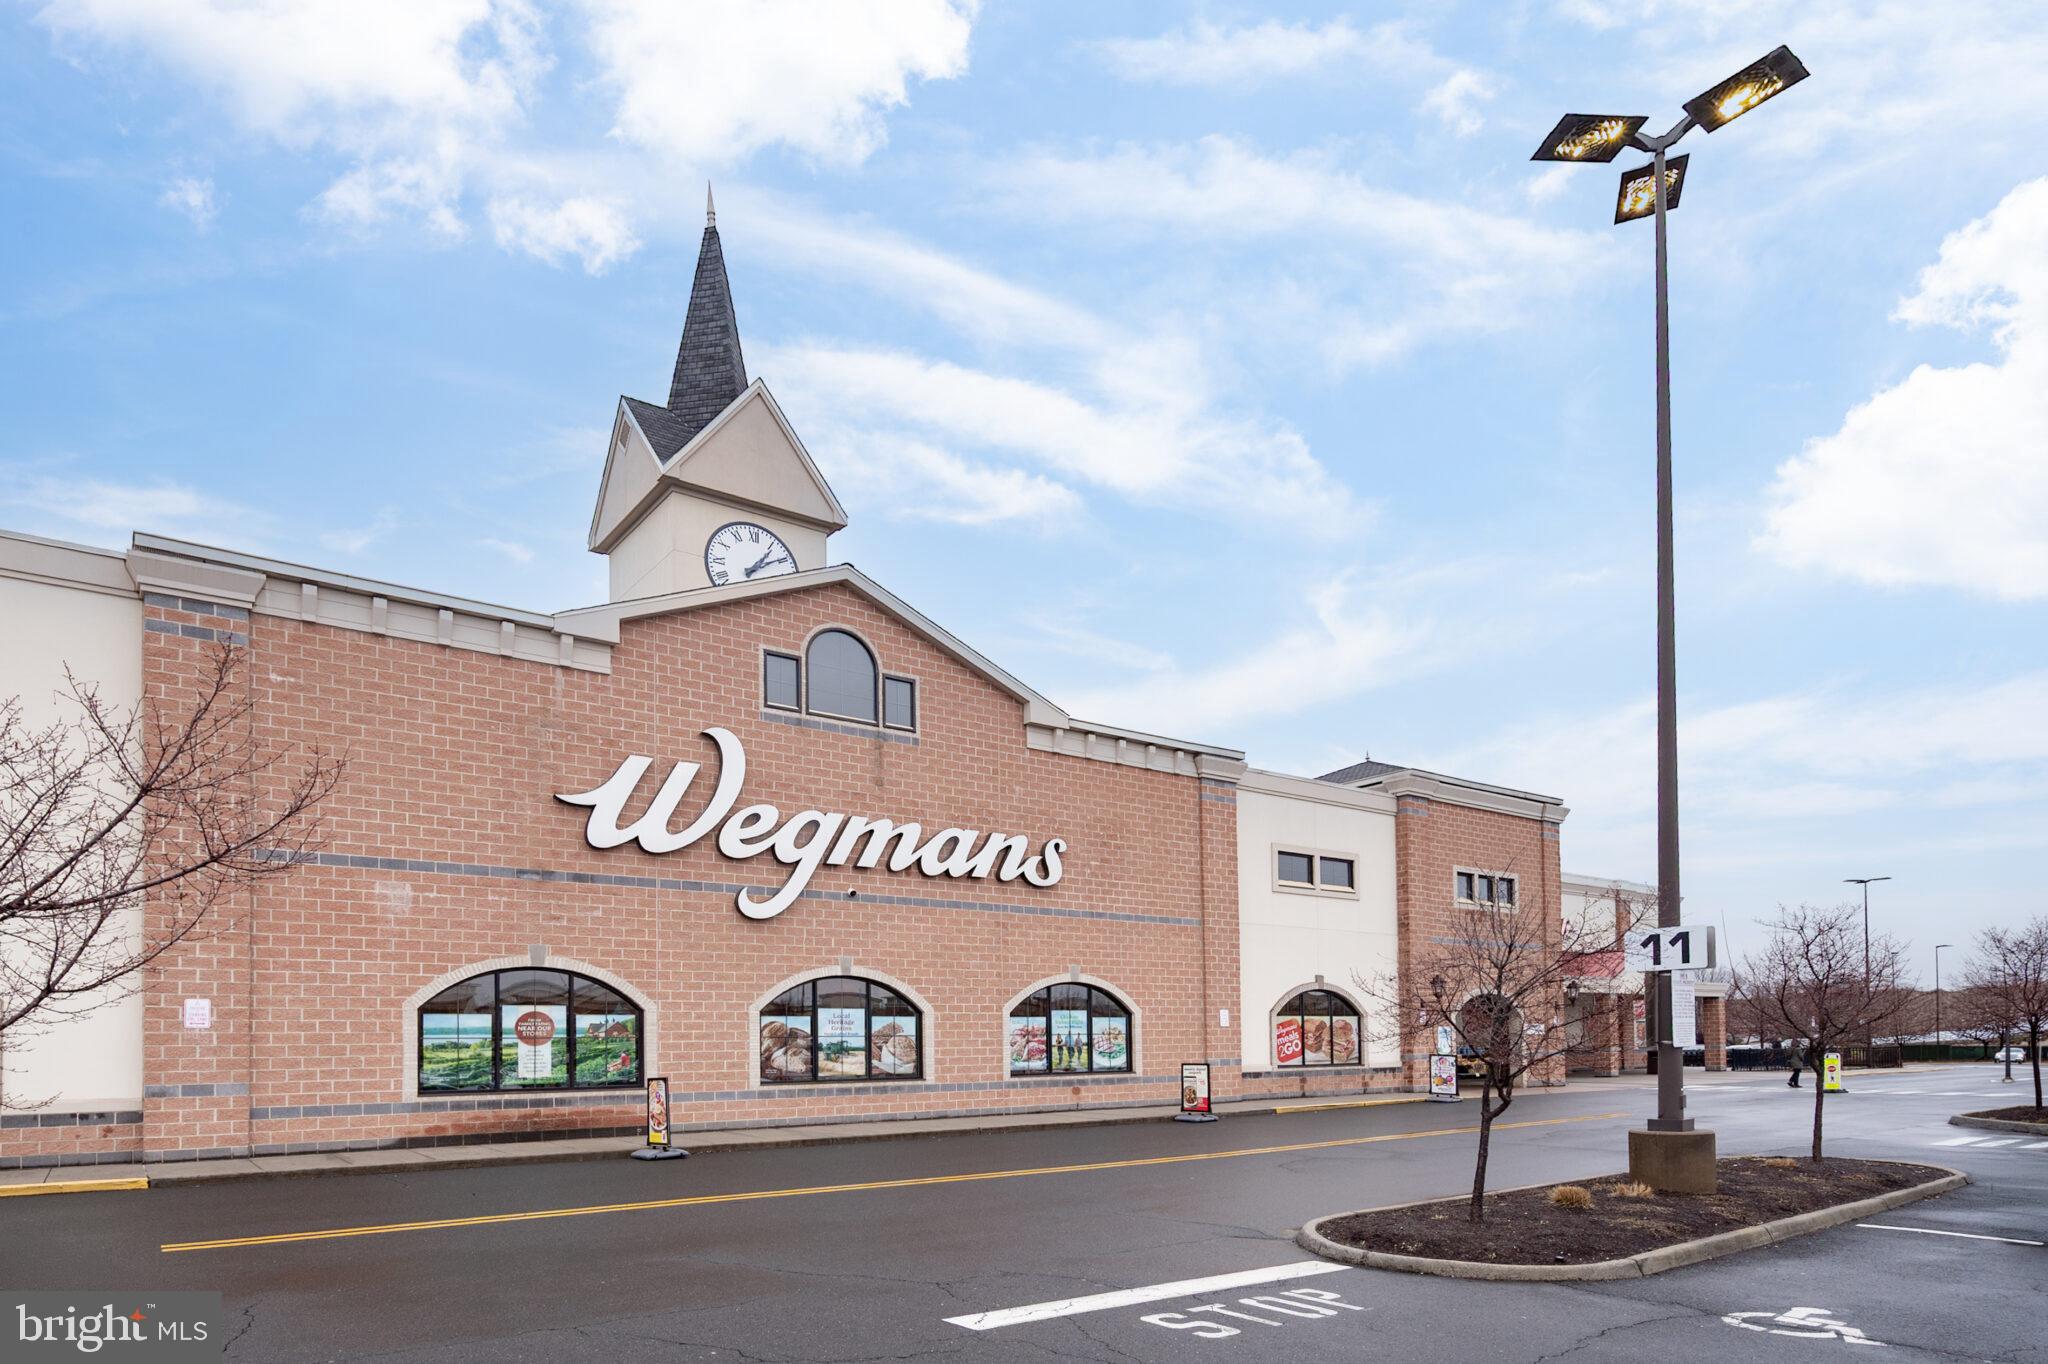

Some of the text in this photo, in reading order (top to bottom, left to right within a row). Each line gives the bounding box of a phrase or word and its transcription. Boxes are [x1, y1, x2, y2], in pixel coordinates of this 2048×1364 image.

[554, 727, 1067, 920] Wegmans
[1640, 931, 1690, 965] 11
[1140, 1288, 1365, 1338] STOP
